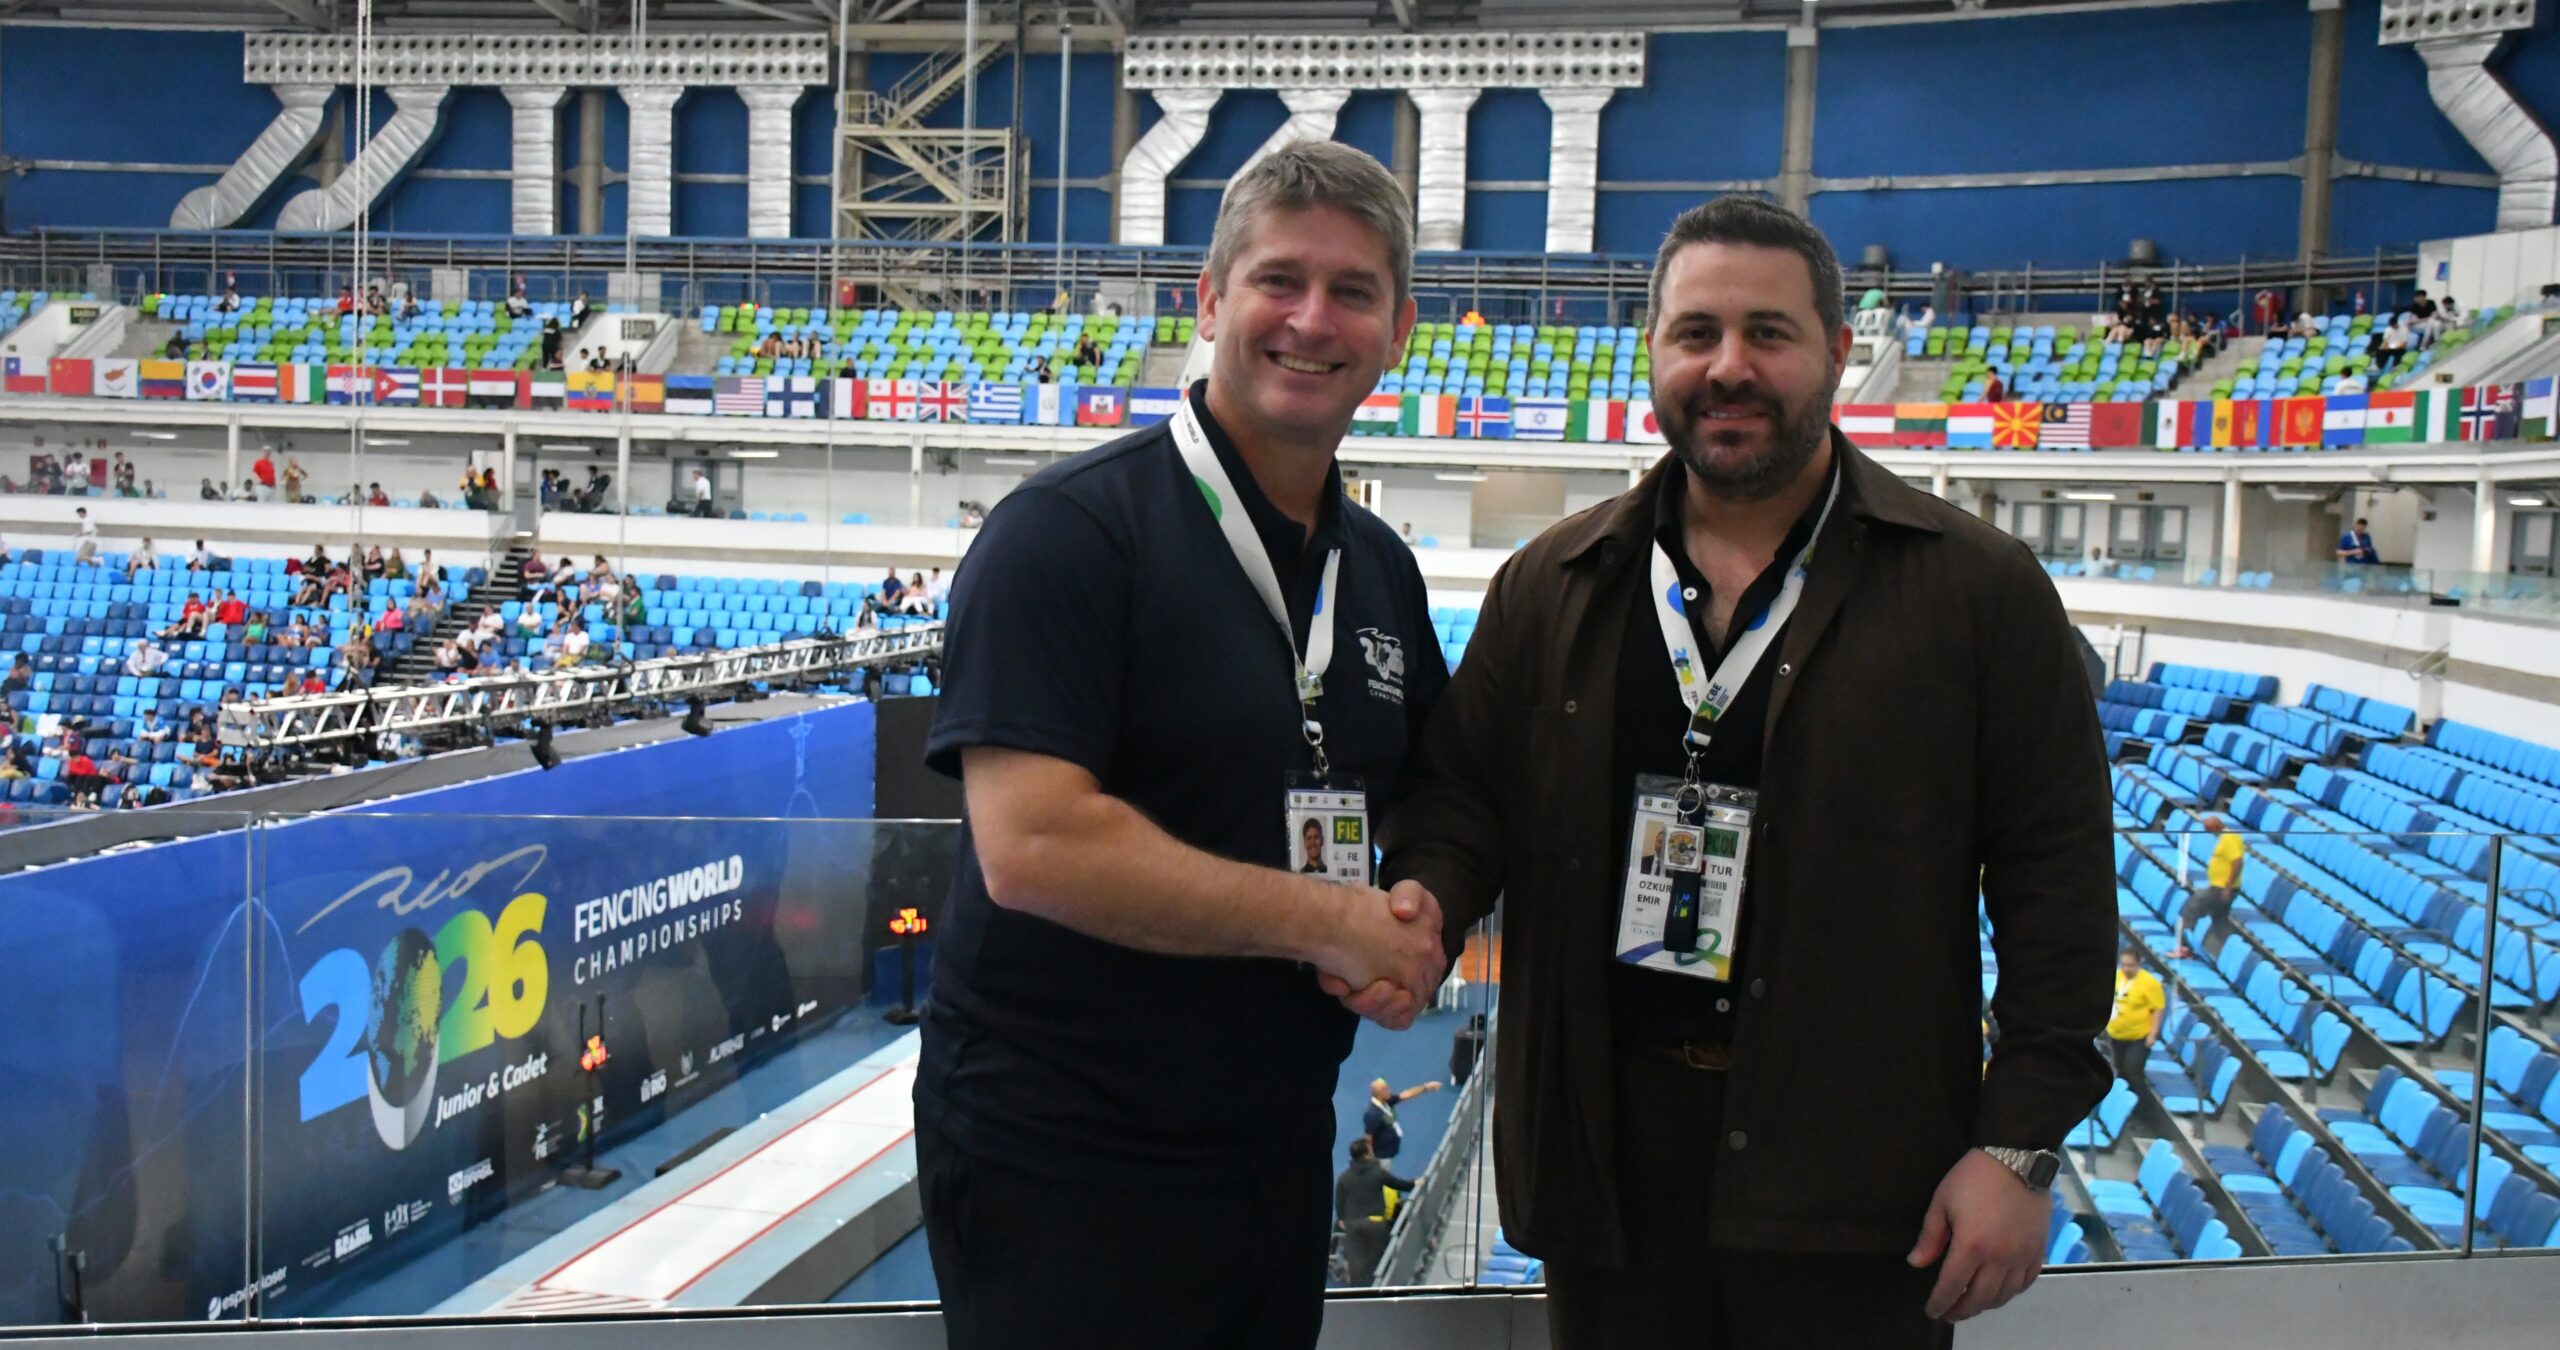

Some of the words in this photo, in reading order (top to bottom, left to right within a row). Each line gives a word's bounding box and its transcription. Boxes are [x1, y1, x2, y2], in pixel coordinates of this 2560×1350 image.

[1706, 682, 1722, 702] CBE
[1336, 821, 1360, 841] FIE
[1347, 852, 1359, 862] FIE
[1711, 864, 1733, 877] TUR
[1637, 894, 1661, 905] EMIR
[574, 898, 743, 985] CHAMPIONSHIPS
[299, 891, 549, 1151] 2026
[434, 1083, 486, 1129] Junior
[486, 1071, 500, 1100] &
[502, 1051, 548, 1092] Cadet
